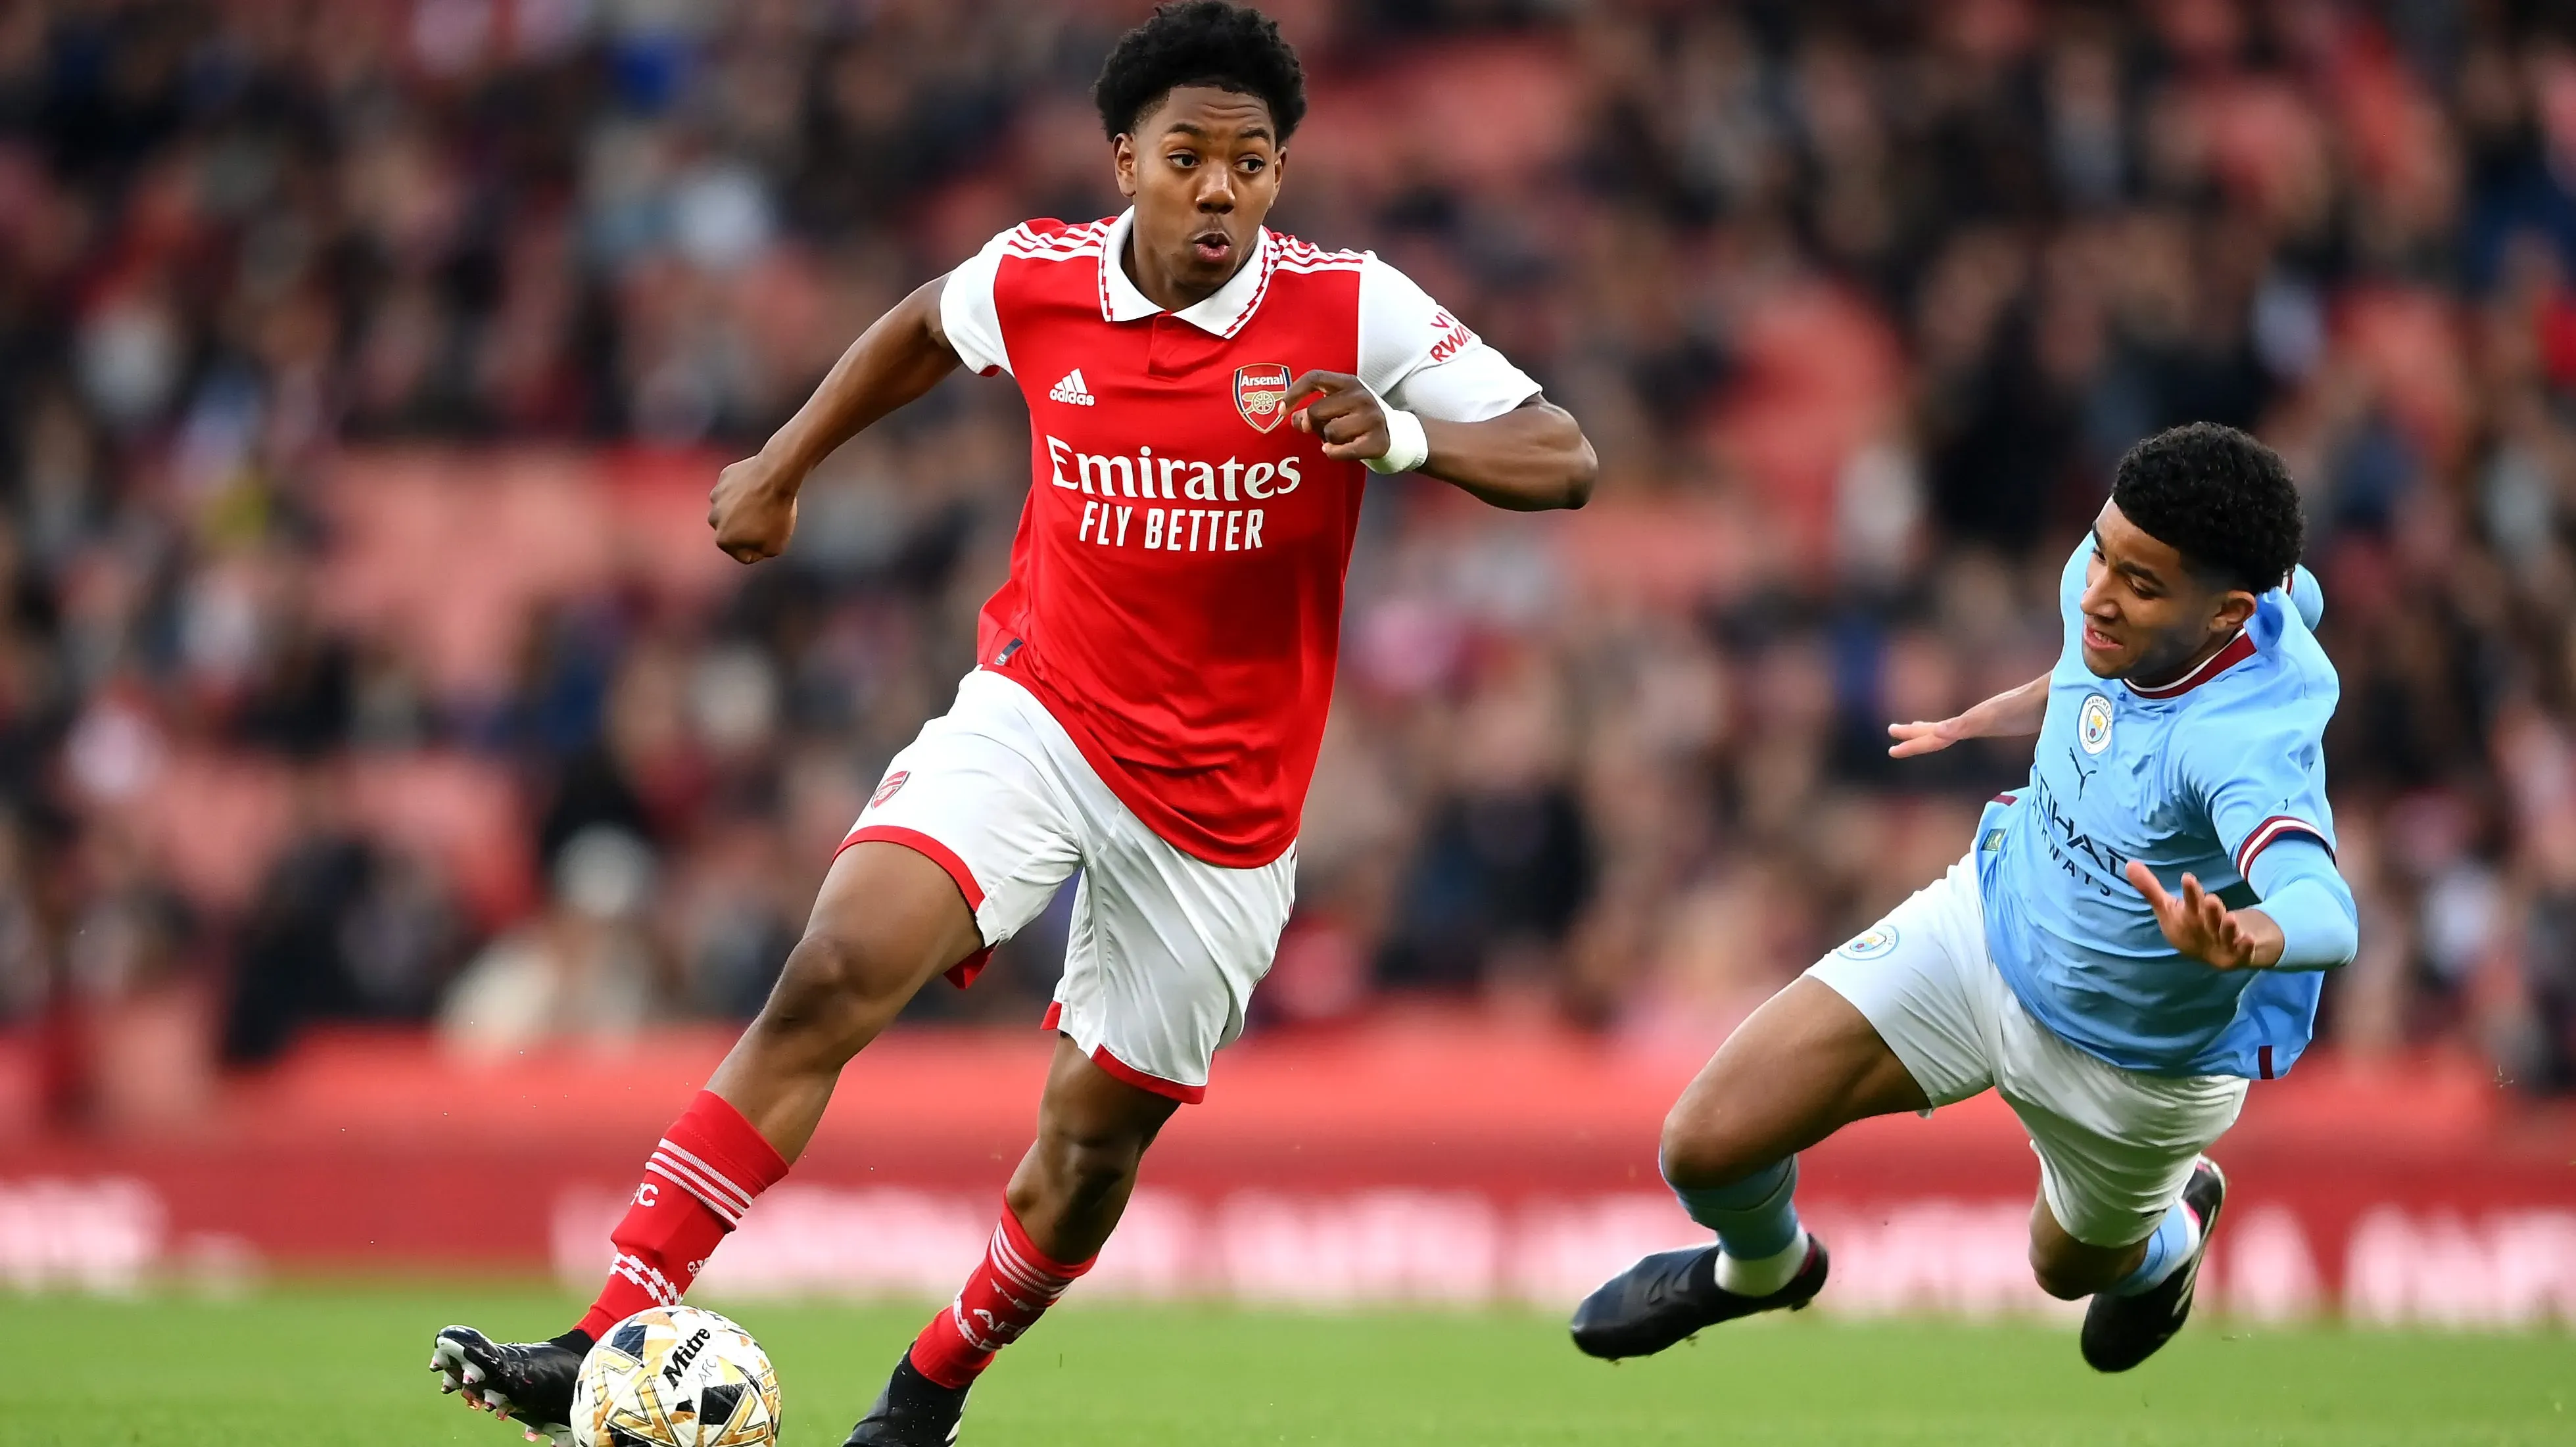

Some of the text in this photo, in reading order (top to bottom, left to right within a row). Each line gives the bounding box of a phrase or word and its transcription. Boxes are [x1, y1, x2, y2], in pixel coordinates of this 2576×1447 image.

[1049, 389, 1095, 406] adidas
[1241, 373, 1284, 387] Arsenal
[1045, 435, 1301, 502] Emirates
[1079, 500, 1264, 552] FLY BETTER
[662, 1328, 711, 1392] Mitre
[699, 1359, 717, 1387] AFC
